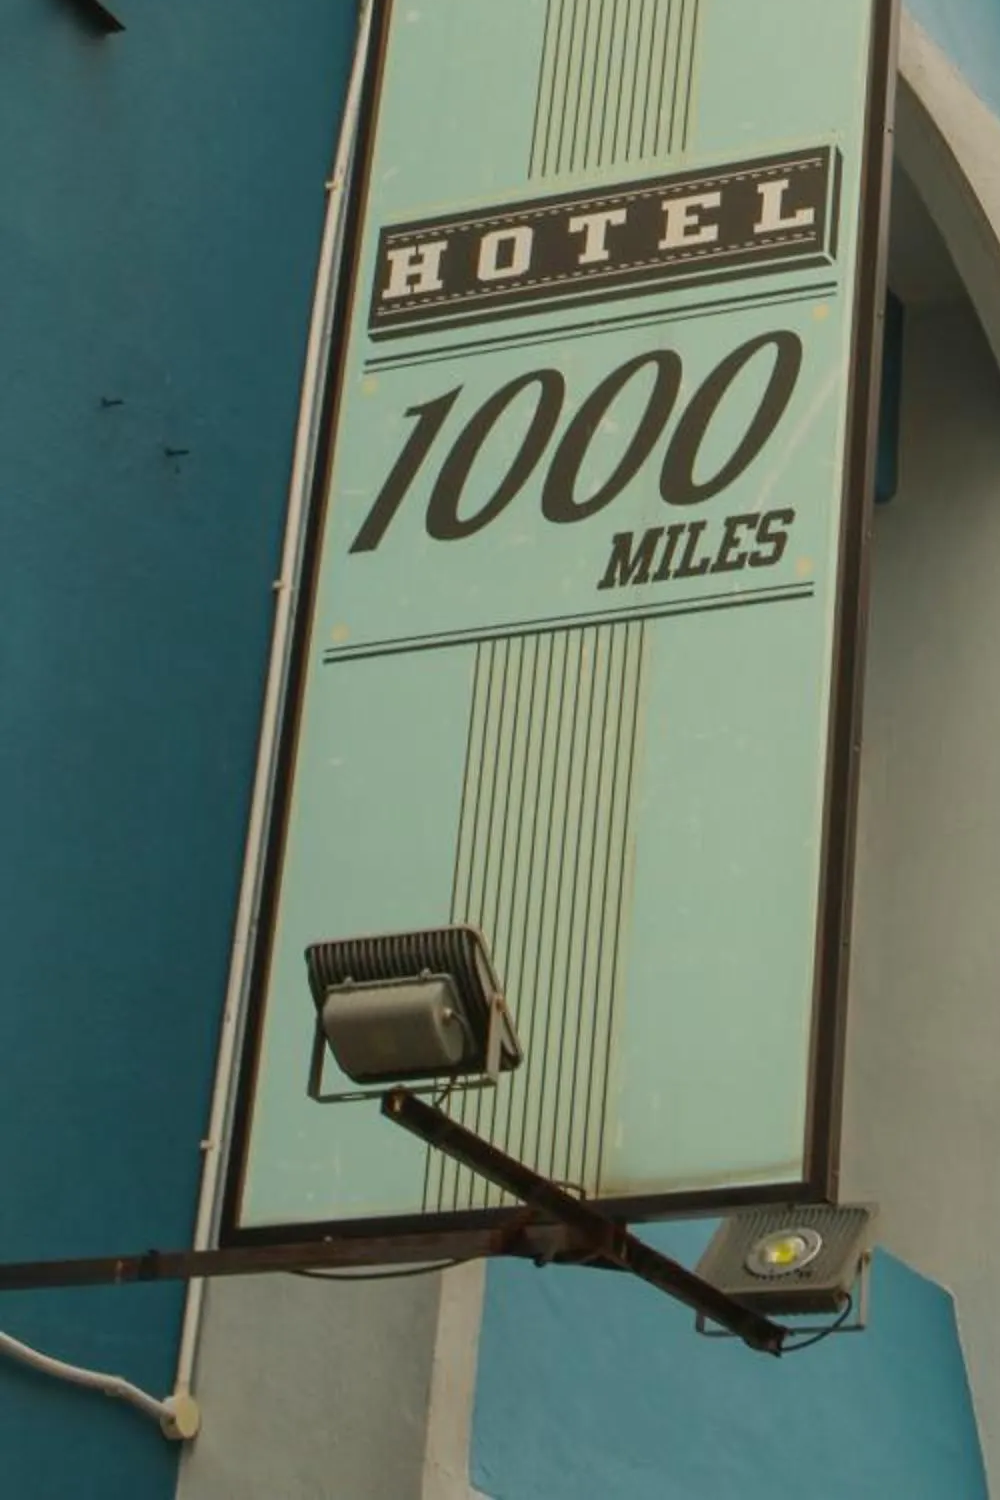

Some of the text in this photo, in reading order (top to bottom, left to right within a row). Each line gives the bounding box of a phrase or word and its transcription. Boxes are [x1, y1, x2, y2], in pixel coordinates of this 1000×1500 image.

[381, 179, 815, 299] HOTEL
[347, 329, 803, 555] 1000
[596, 508, 796, 590] MILES
